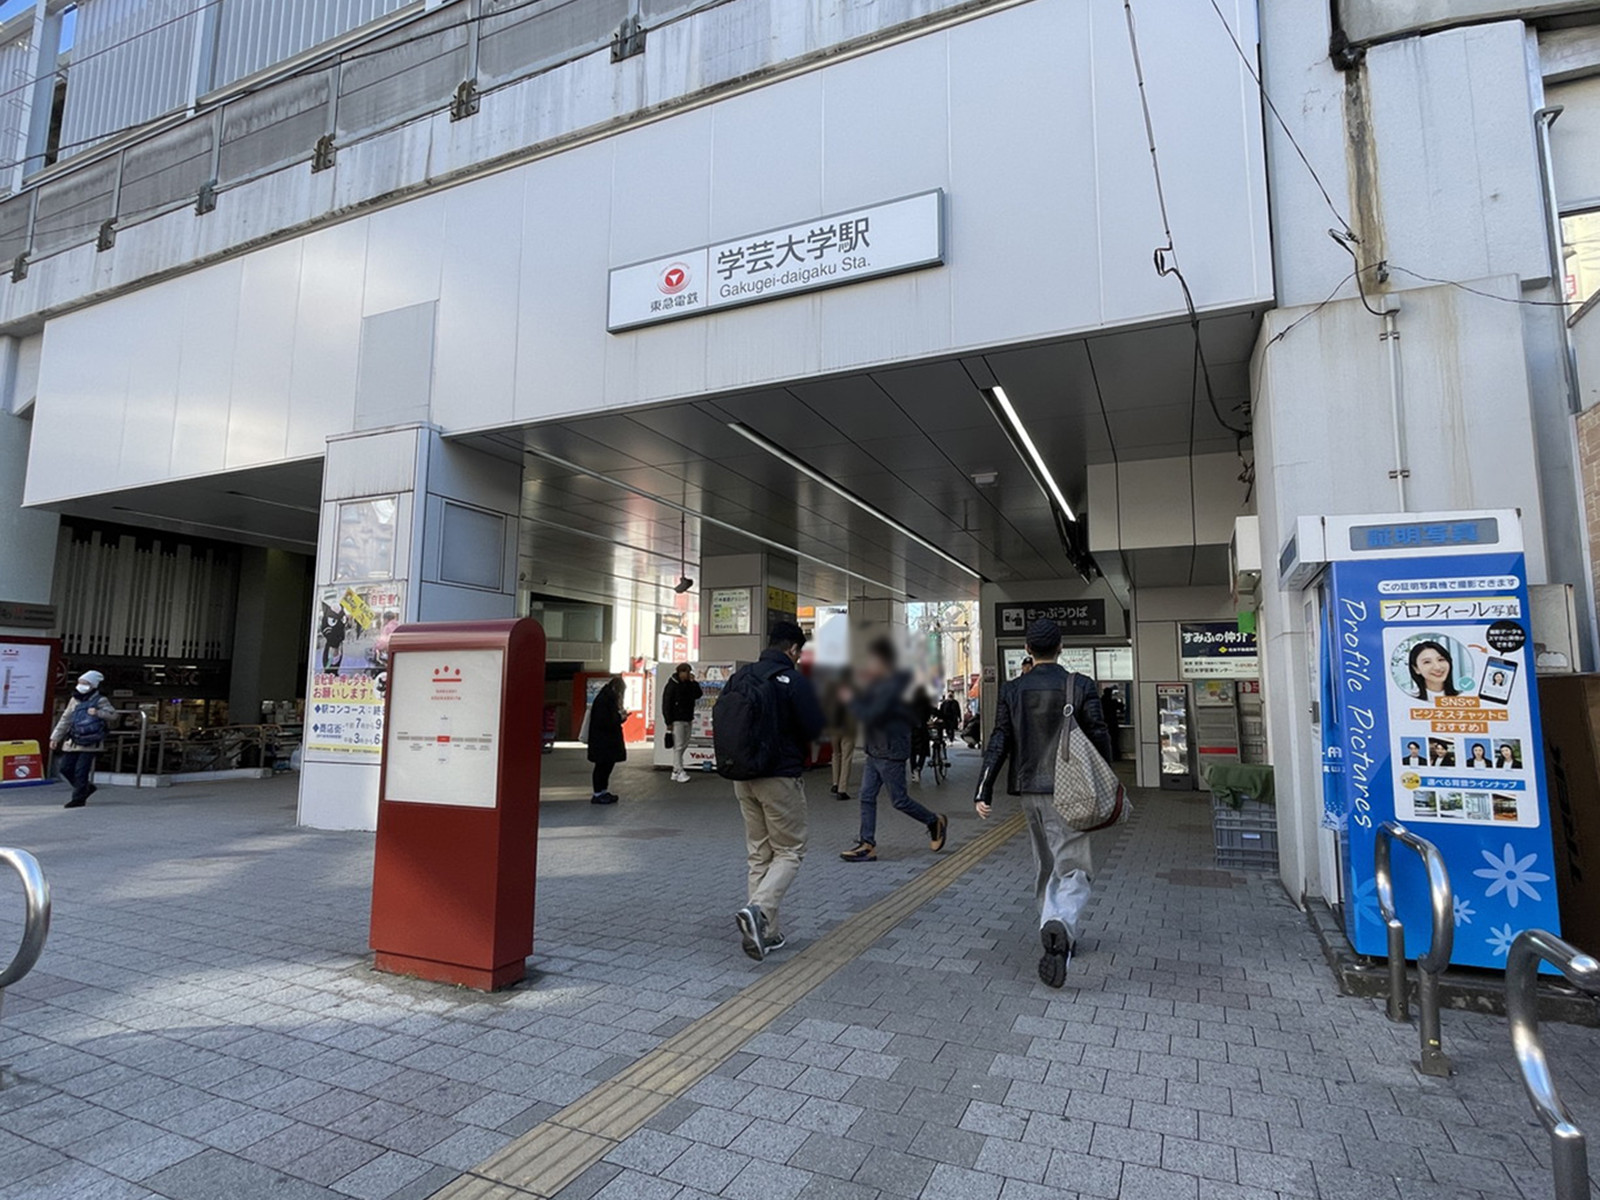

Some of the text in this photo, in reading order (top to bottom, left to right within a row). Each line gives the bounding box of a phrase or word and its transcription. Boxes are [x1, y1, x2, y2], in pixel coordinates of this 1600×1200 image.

[717, 217, 870, 280] 学芸大学駅
[720, 256, 871, 299] Gakugei-daigaku Sta.
[650, 291, 699, 312] 東急電鉄
[1367, 522, 1479, 547] 証明写真
[1382, 578, 1517, 592] この証明写真機で撮影できます
[1026, 606, 1088, 619] きっぷうりば
[1384, 600, 1519, 620] プロフィール写真
[1182, 631, 1248, 644] すみふの仲介
[1440, 698, 1476, 706] SNSや
[1340, 598, 1375, 829] Profile Pictures
[1412, 710, 1507, 720] ビジネスチャットに
